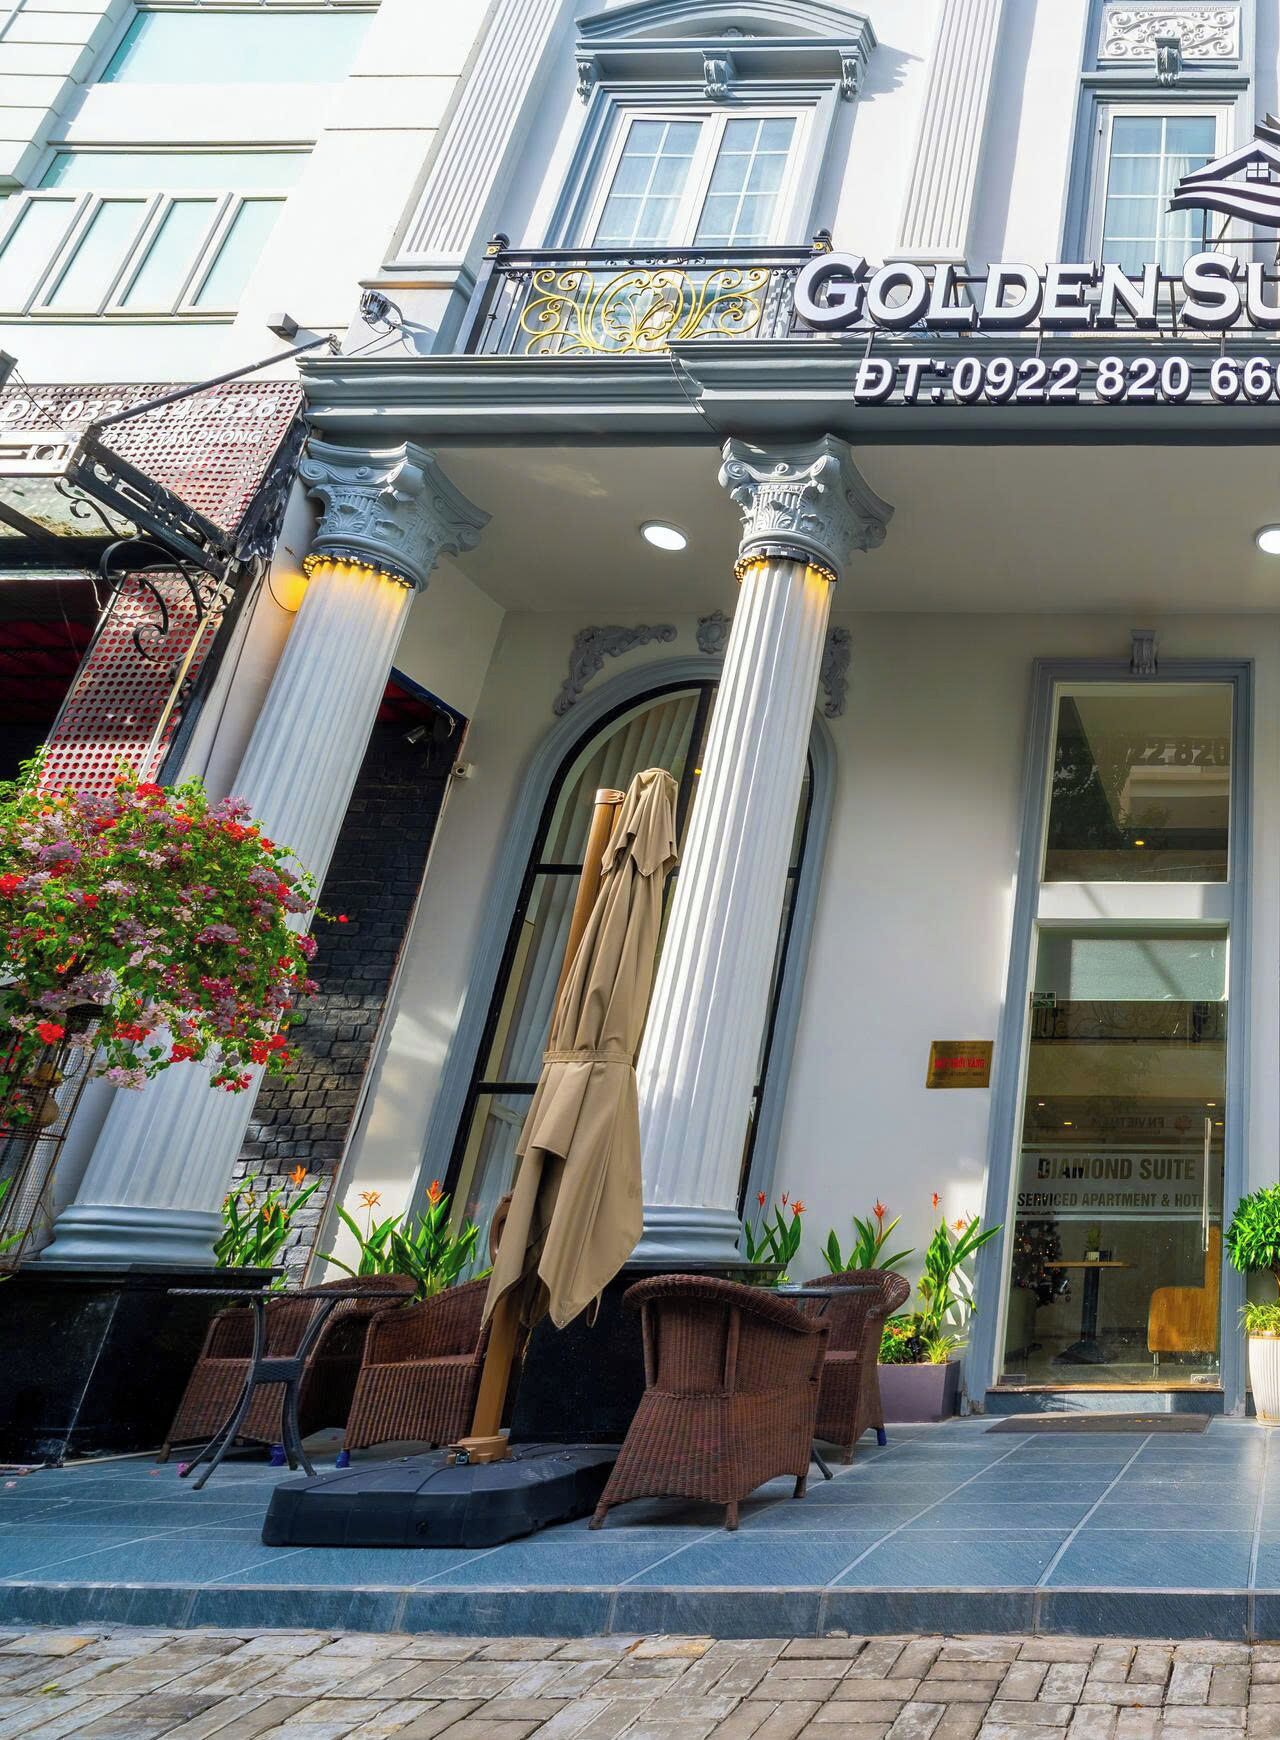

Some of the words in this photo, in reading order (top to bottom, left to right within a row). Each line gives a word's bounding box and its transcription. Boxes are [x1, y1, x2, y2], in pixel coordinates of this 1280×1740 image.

[794, 251, 1161, 330] GOLDEN
[1096, 356, 1192, 402] 820
[1037, 1158, 1133, 1180] DIAMOND
[1139, 1158, 1196, 1180] SUITE
[1016, 1192, 1078, 1207] SERVICED
[1081, 1192, 1158, 1208] APARTMENT
[1160, 1193, 1170, 1208] &
